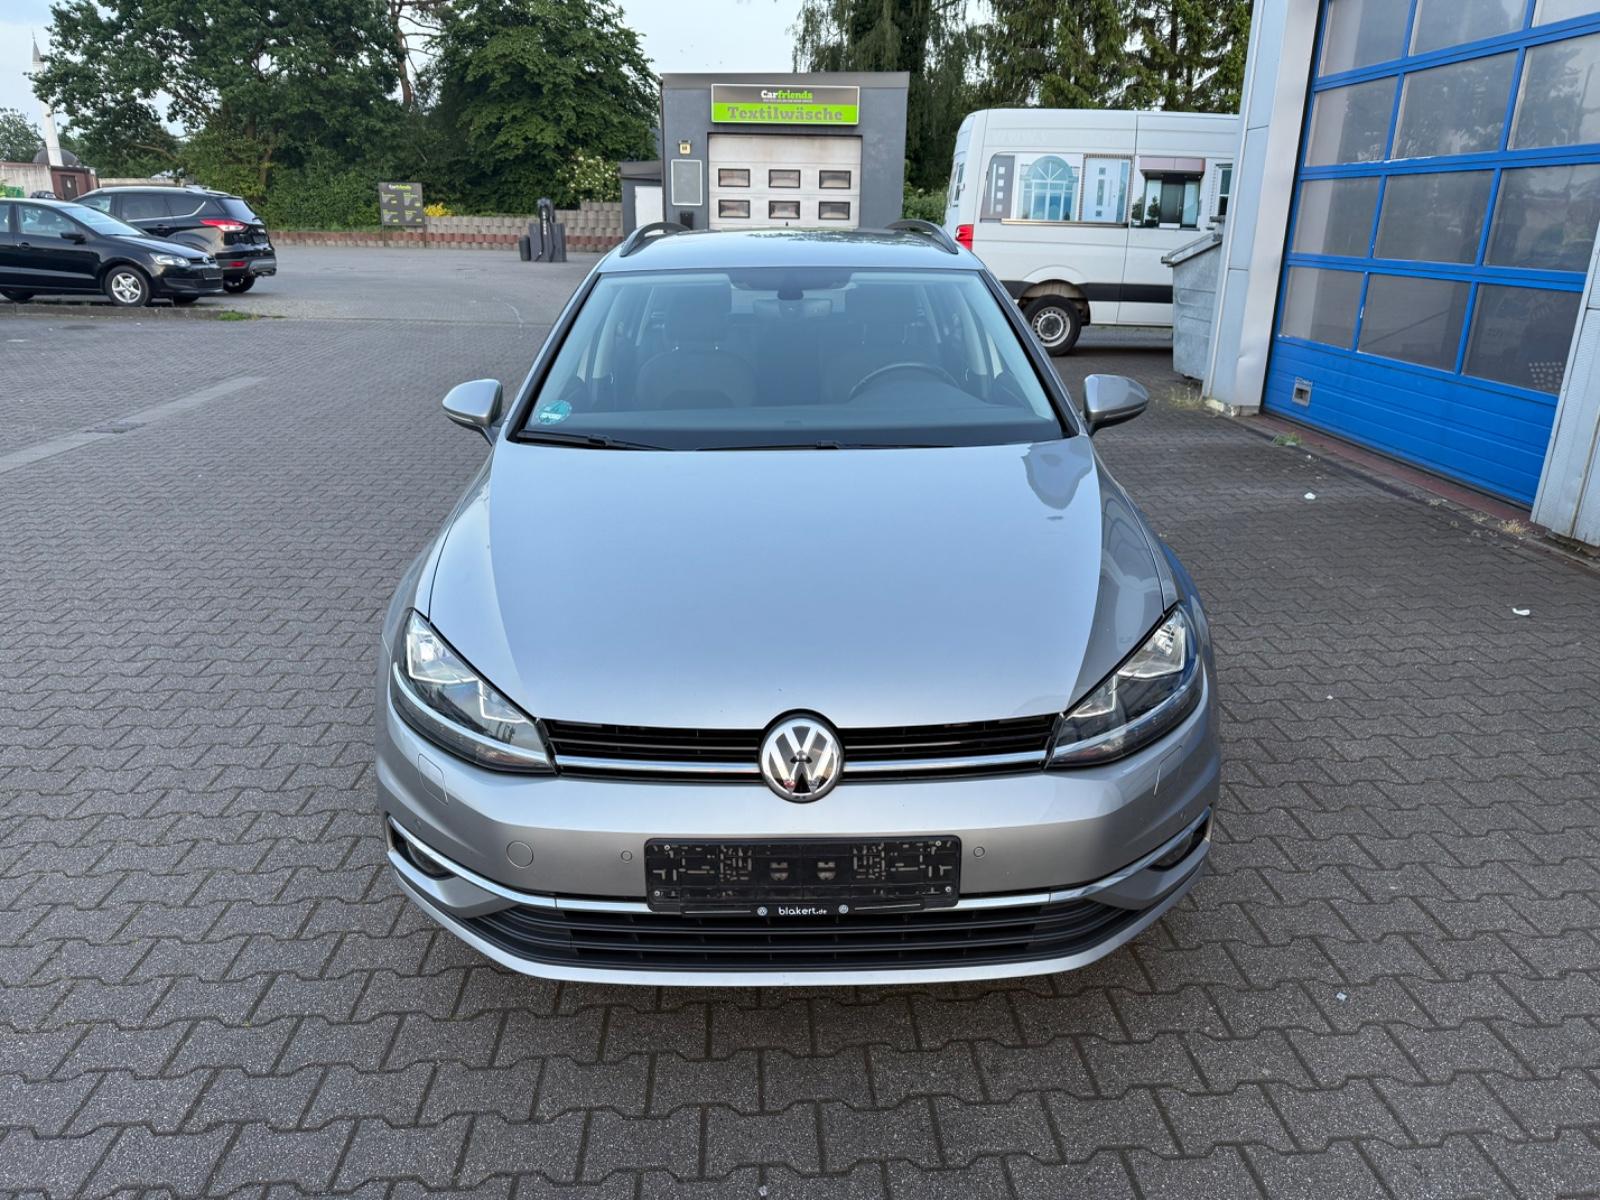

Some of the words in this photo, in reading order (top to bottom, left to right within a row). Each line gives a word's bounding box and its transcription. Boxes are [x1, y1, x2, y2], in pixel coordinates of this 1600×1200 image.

[760, 89, 813, 99] Carfriends
[728, 106, 843, 121] Textilwäsche
[761, 714, 840, 798] VW
[778, 906, 828, 916] blakert.de
